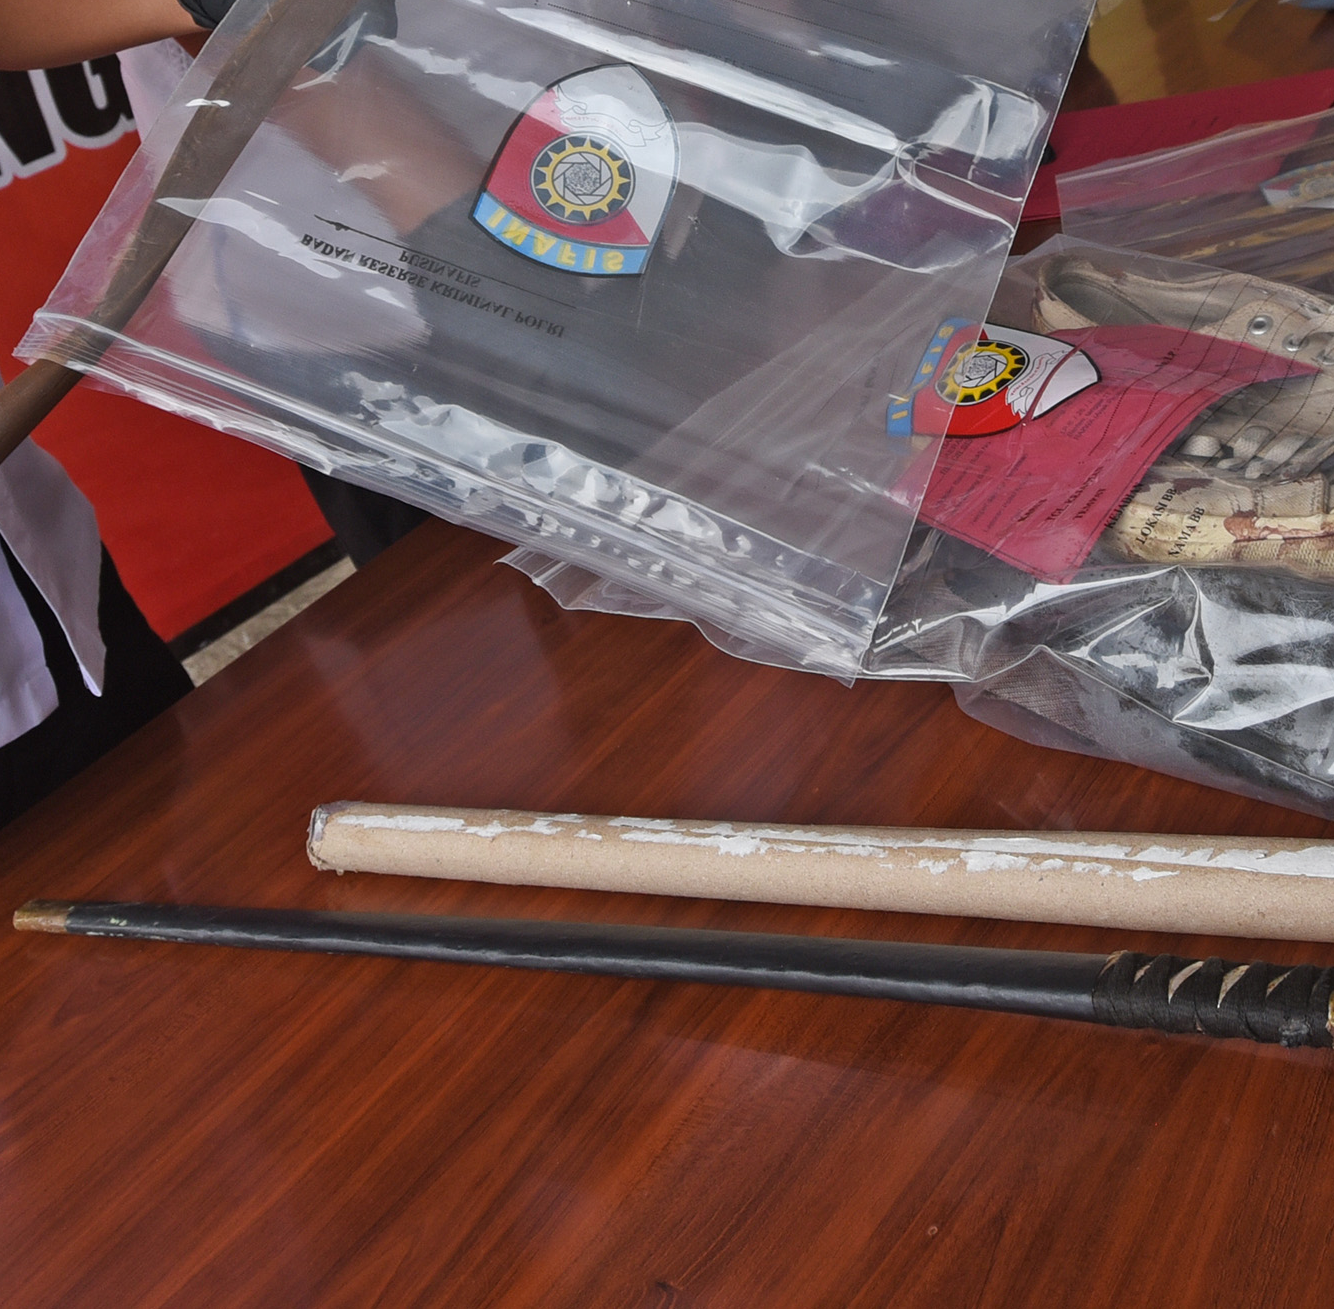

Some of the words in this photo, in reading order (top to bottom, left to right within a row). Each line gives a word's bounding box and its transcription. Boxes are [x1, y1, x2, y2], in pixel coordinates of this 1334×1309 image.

[1135, 501, 1168, 545] LOKASI
[1159, 487, 1178, 502] BB
[1168, 525, 1197, 558] NAMA
[1187, 505, 1207, 523] BB
